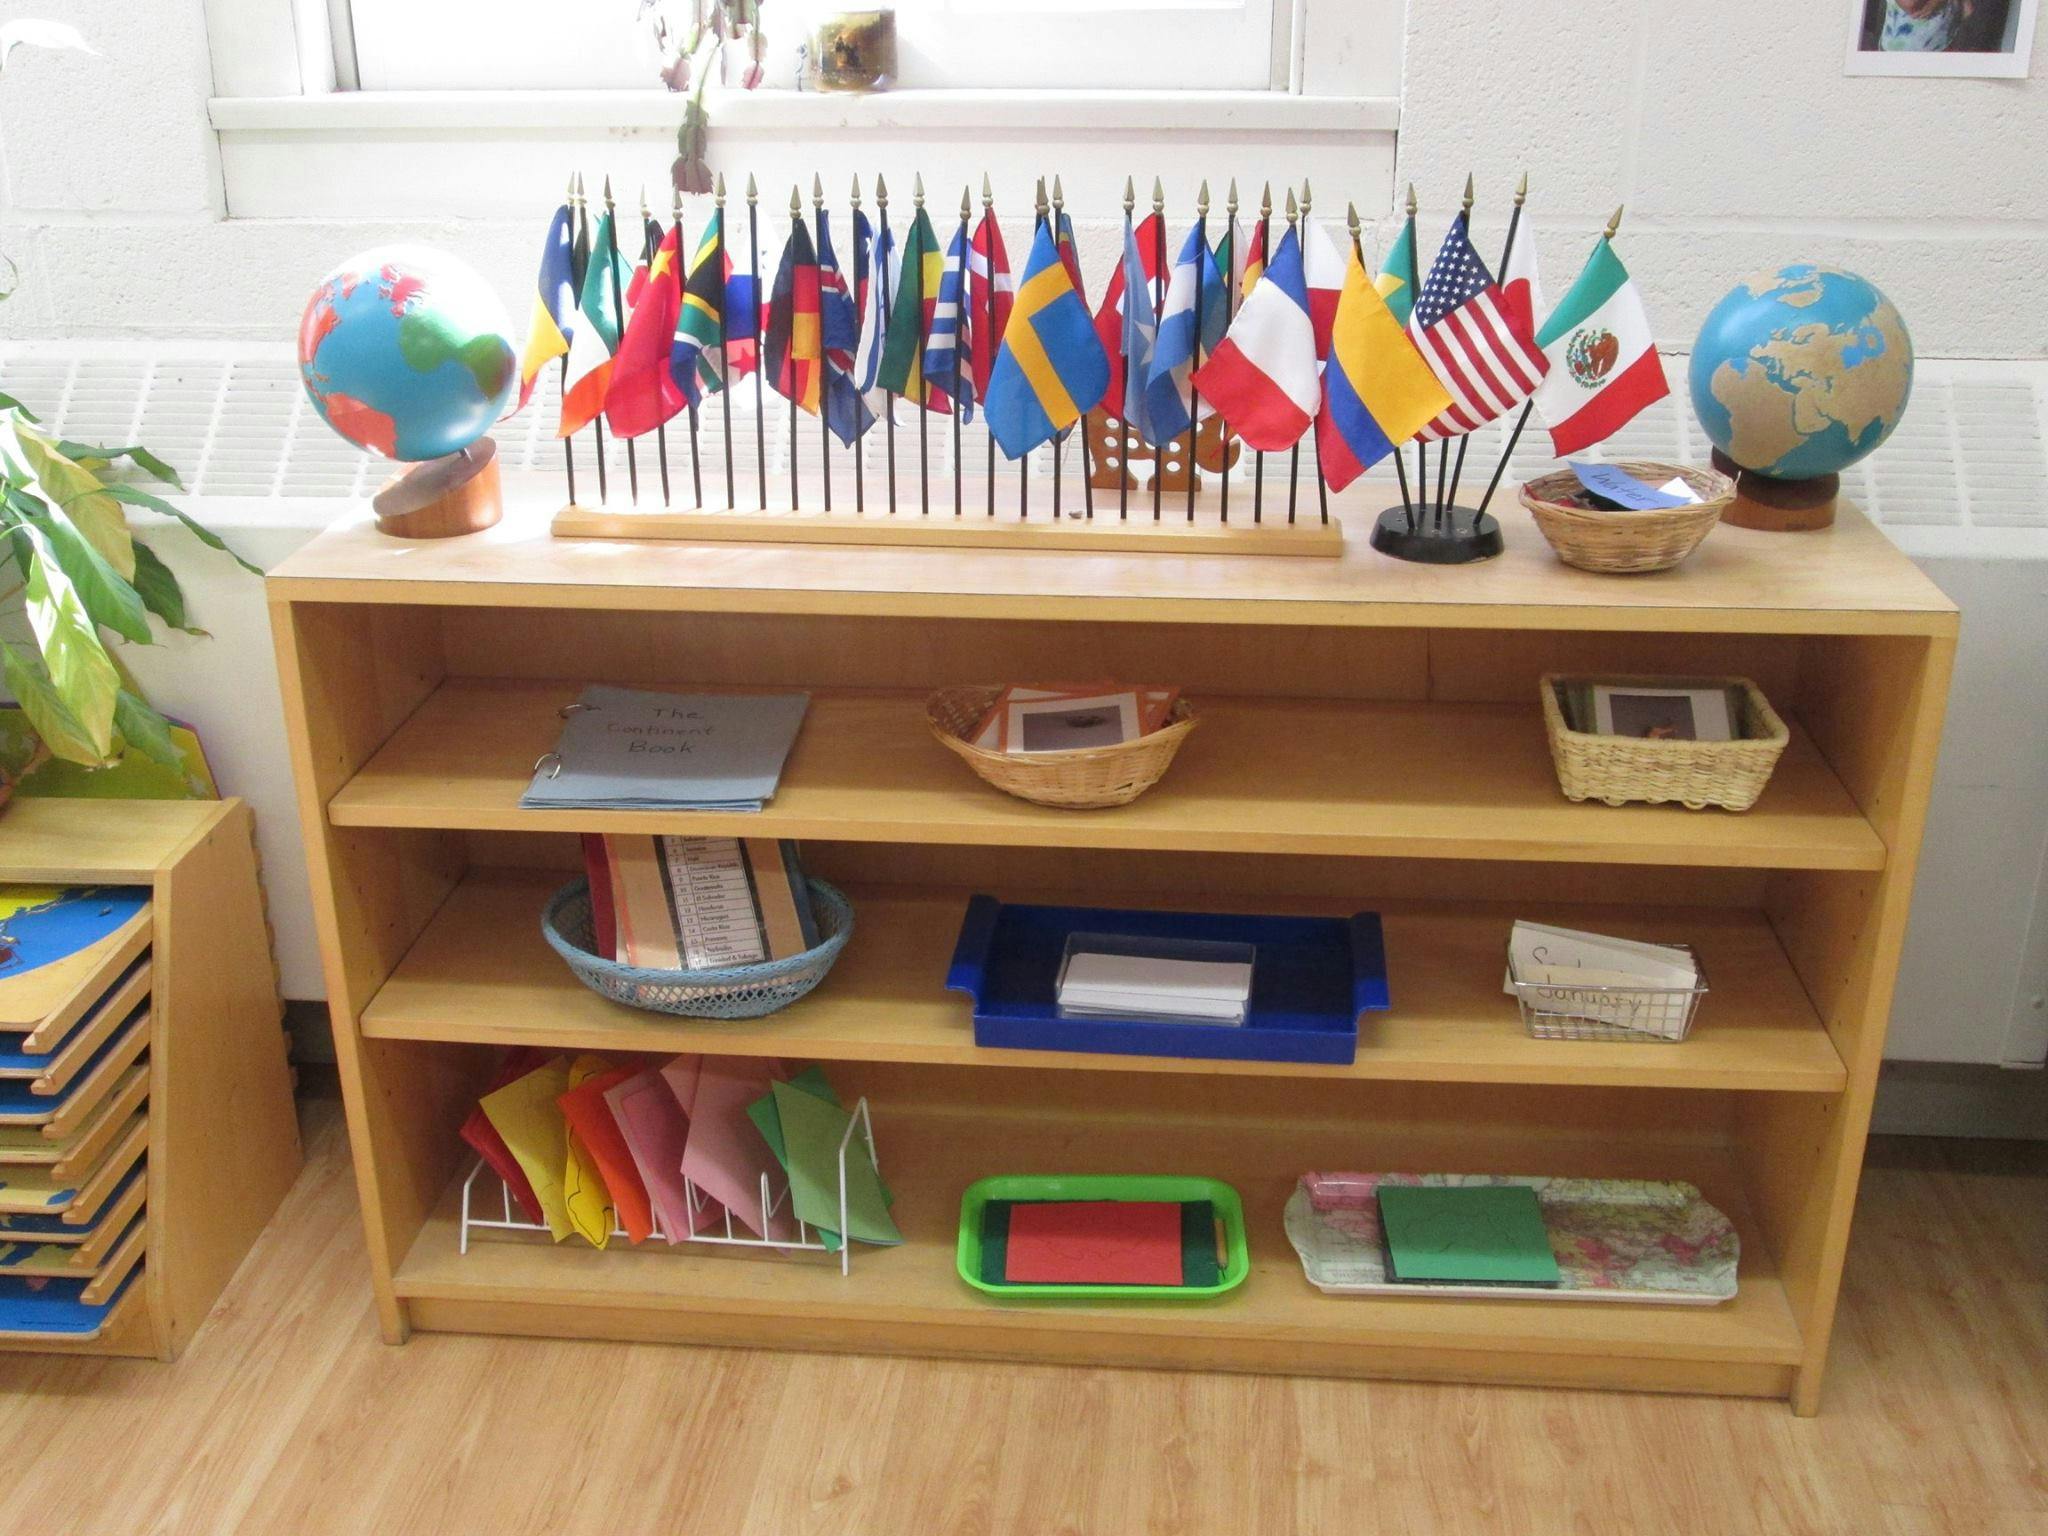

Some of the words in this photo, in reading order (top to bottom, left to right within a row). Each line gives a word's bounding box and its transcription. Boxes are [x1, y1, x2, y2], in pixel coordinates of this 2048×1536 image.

[1591, 473, 1659, 503] Water
[654, 707, 704, 720] The
[606, 723, 716, 737] Continent
[628, 741, 696, 754] Book
[1537, 974, 1642, 1017] January
